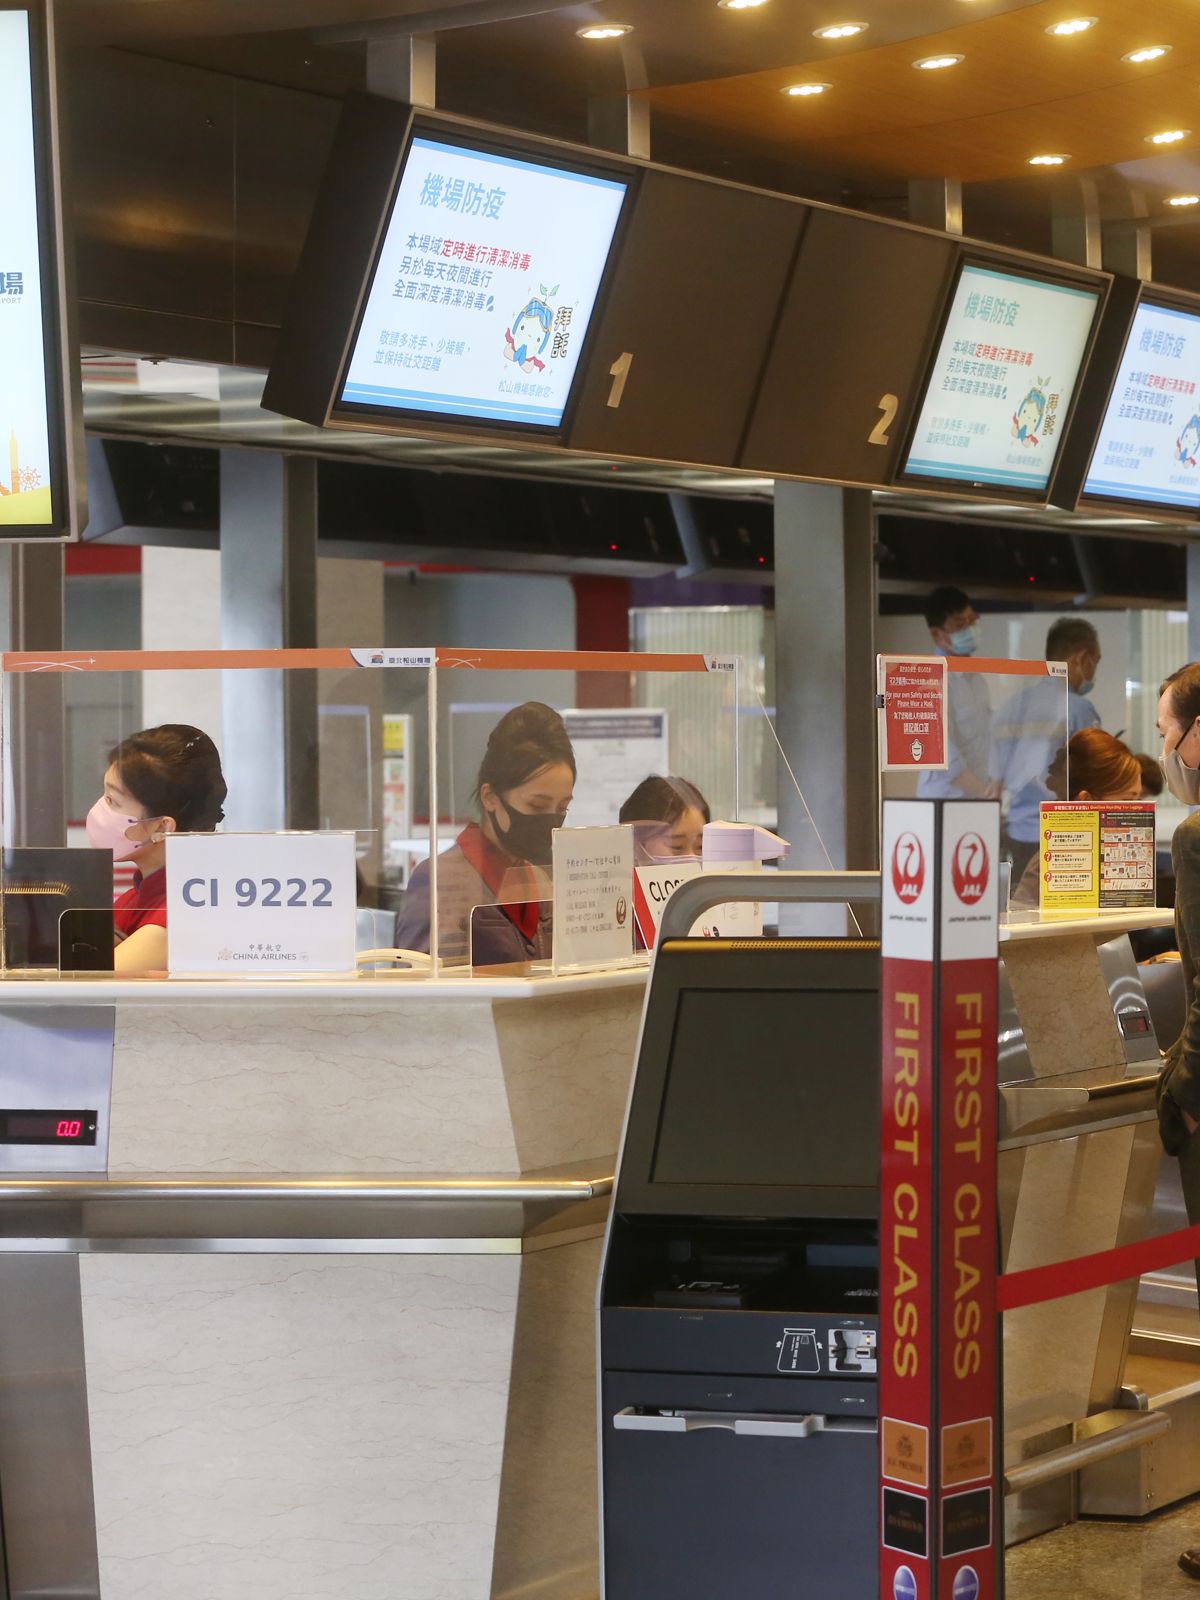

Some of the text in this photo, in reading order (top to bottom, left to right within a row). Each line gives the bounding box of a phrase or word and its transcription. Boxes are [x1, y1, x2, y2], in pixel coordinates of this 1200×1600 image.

[419, 172, 507, 220] 機場防疫
[406, 232, 531, 271] 本場域定時進行清潔消毒
[399, 256, 493, 288] 另於每天夜間進行
[392, 279, 486, 311] 全面深度清潔消毒
[963, 291, 1020, 327] 機場防疫
[551, 306, 573, 358] 拜託
[607, 352, 633, 408] 1
[868, 393, 898, 445] 2
[182, 878, 333, 908] CI 9222
[899, 884, 919, 896] JAL
[961, 884, 982, 897] JAL
[249, 944, 282, 952] 中華航空
[261, 953, 297, 961] AIRLINES
[56, 1121, 81, 1137] 0.0
[893, 992, 920, 1377] FIRST CLASS
[954, 992, 982, 1379] FIRST CLASS
